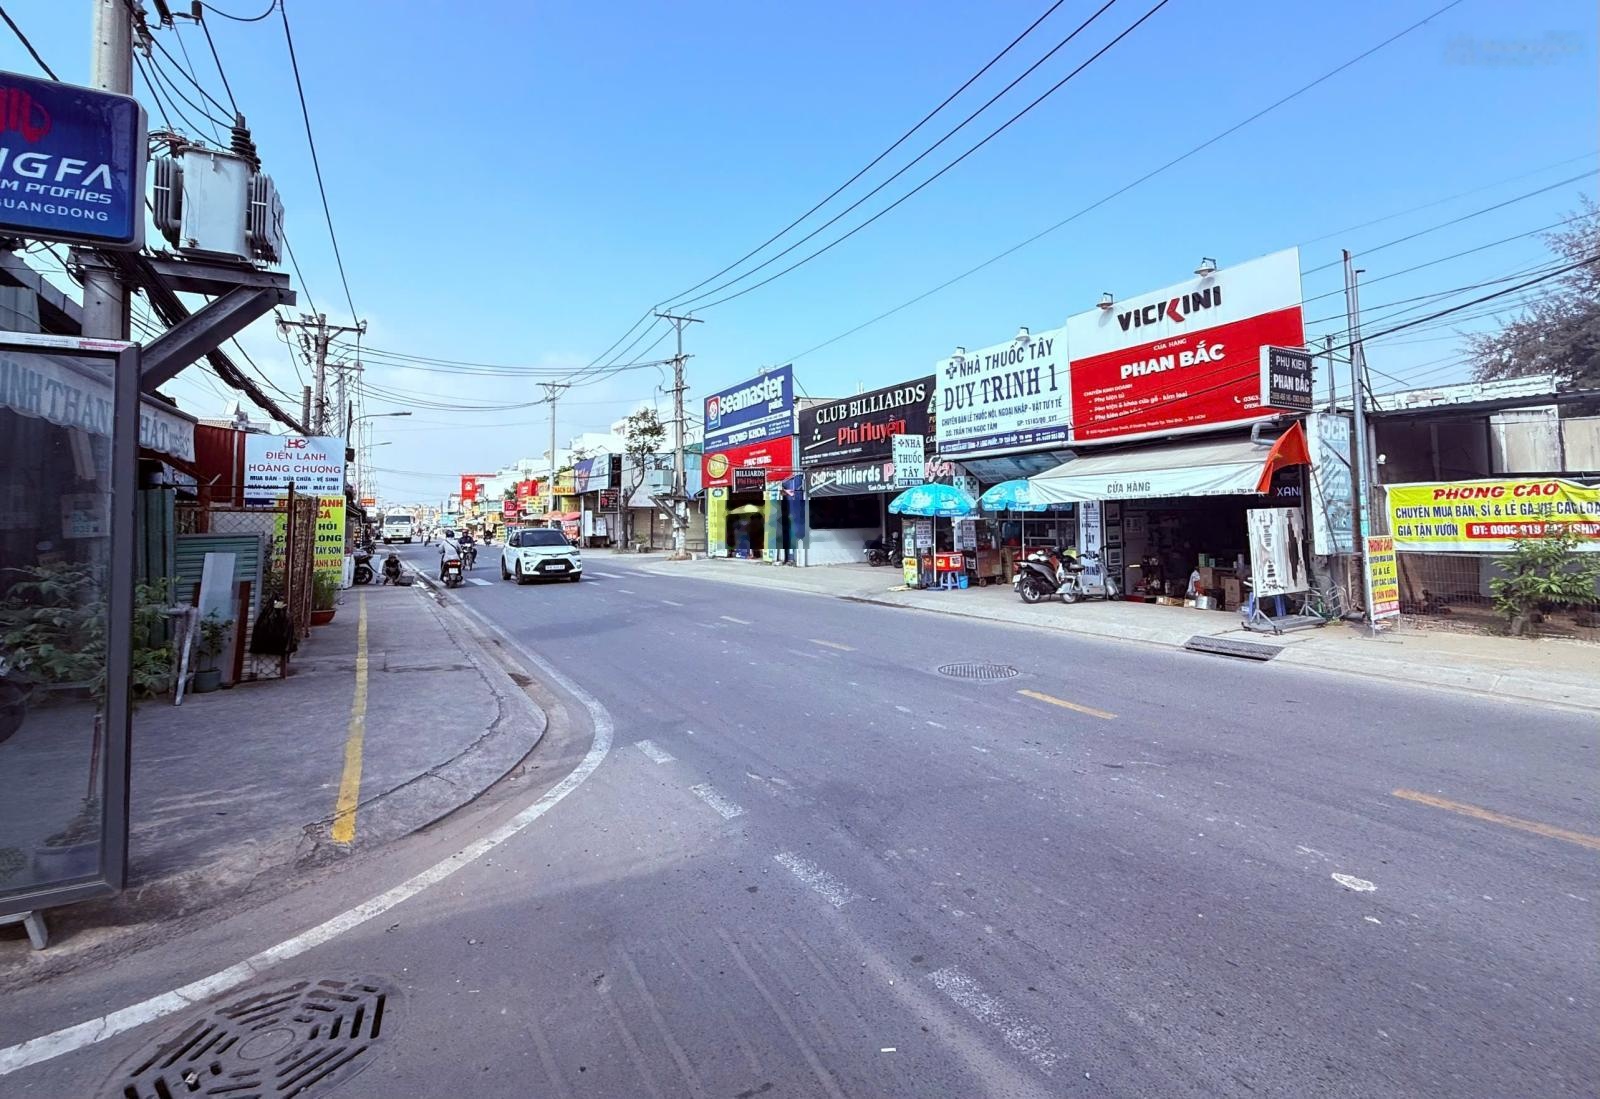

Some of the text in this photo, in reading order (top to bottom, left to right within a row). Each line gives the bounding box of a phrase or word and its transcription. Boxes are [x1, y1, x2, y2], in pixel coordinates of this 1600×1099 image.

[0, 197, 109, 222] UANGDONG
[1117, 286, 1222, 331] VICKINI
[959, 337, 1054, 378] NHÀ THUỐC TÂY
[1120, 339, 1226, 380] PHAN BẮC
[944, 364, 1058, 412] DUY TRINH 1
[1273, 374, 1294, 391] PHAN
[720, 375, 784, 415] seamaster
[816, 406, 847, 425] CLUB
[849, 383, 926, 418] BILLIARDS
[837, 423, 858, 447] Phi
[248, 462, 290, 473] HOÀNG
[899, 451, 923, 464] THUỐC
[902, 466, 919, 477] TÂY
[1107, 480, 1124, 494] CỬA
[1126, 480, 1151, 492] HÀNG
[1432, 504, 1453, 518] MUA
[1494, 505, 1502, 516] &
